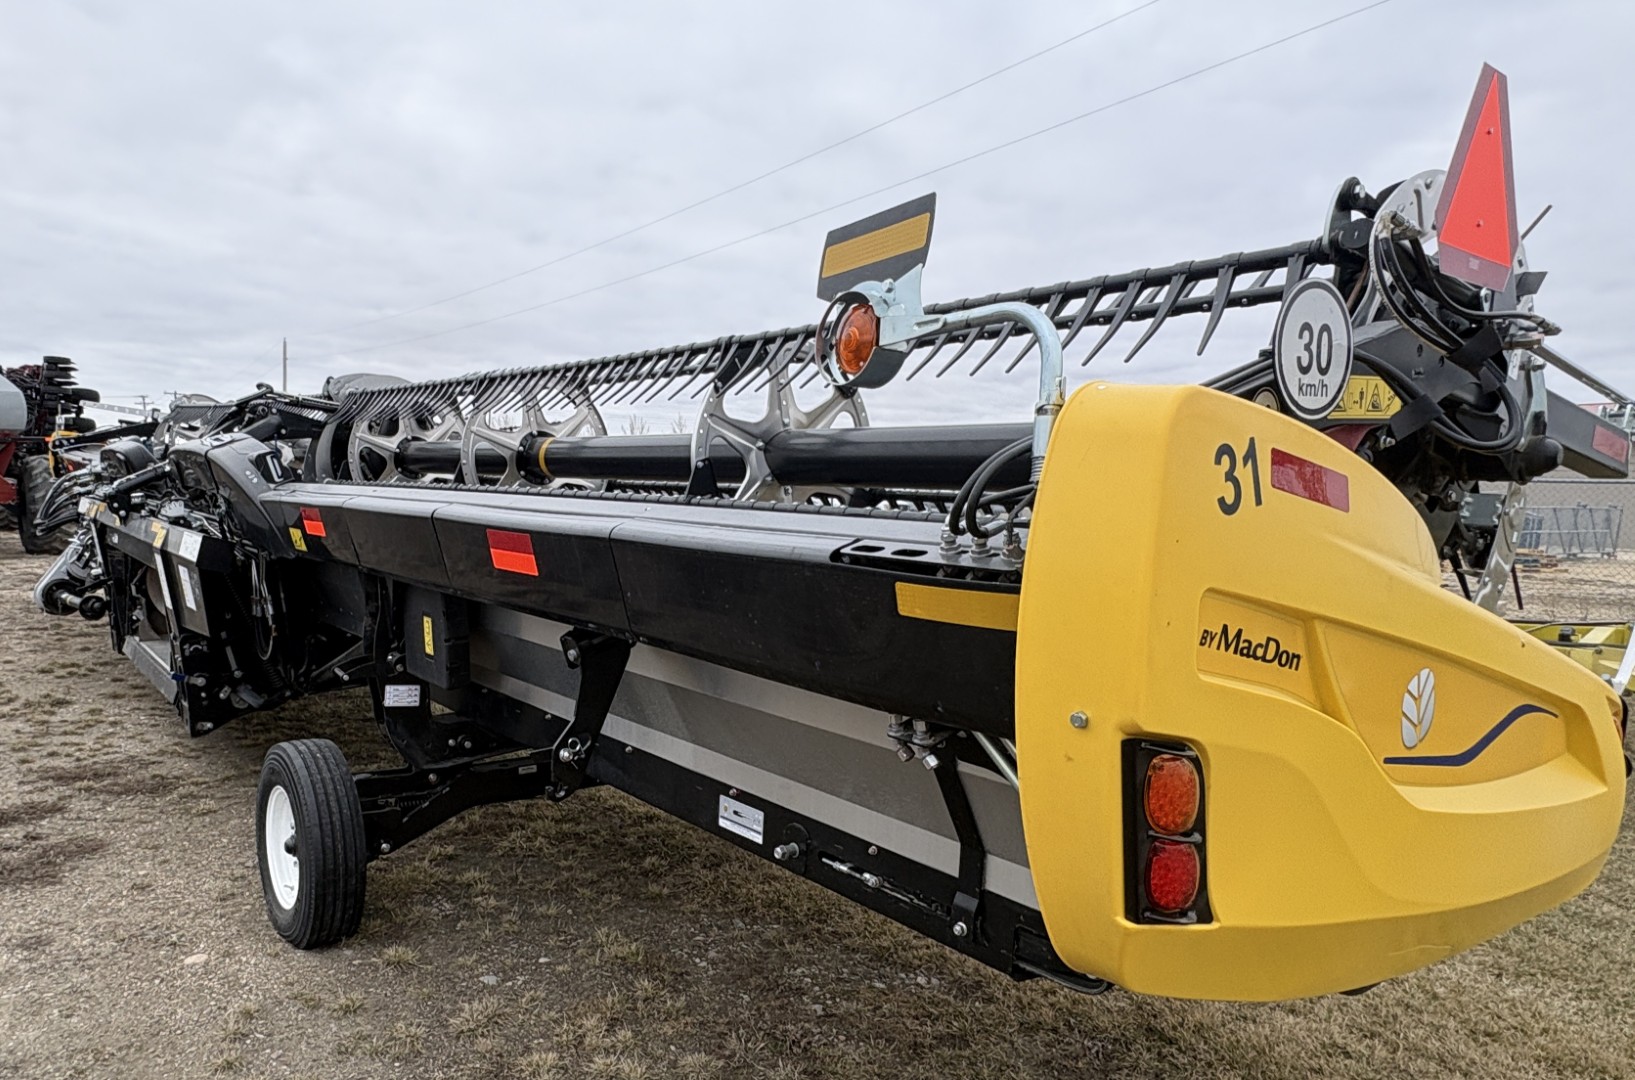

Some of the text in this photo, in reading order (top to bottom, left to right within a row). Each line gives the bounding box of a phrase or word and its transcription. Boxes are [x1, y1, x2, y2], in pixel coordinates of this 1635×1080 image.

[1296, 321, 1333, 376] 30
[1298, 377, 1328, 397] km/h
[1214, 436, 1262, 516] 31
[1199, 623, 1301, 671] BY MacDon
